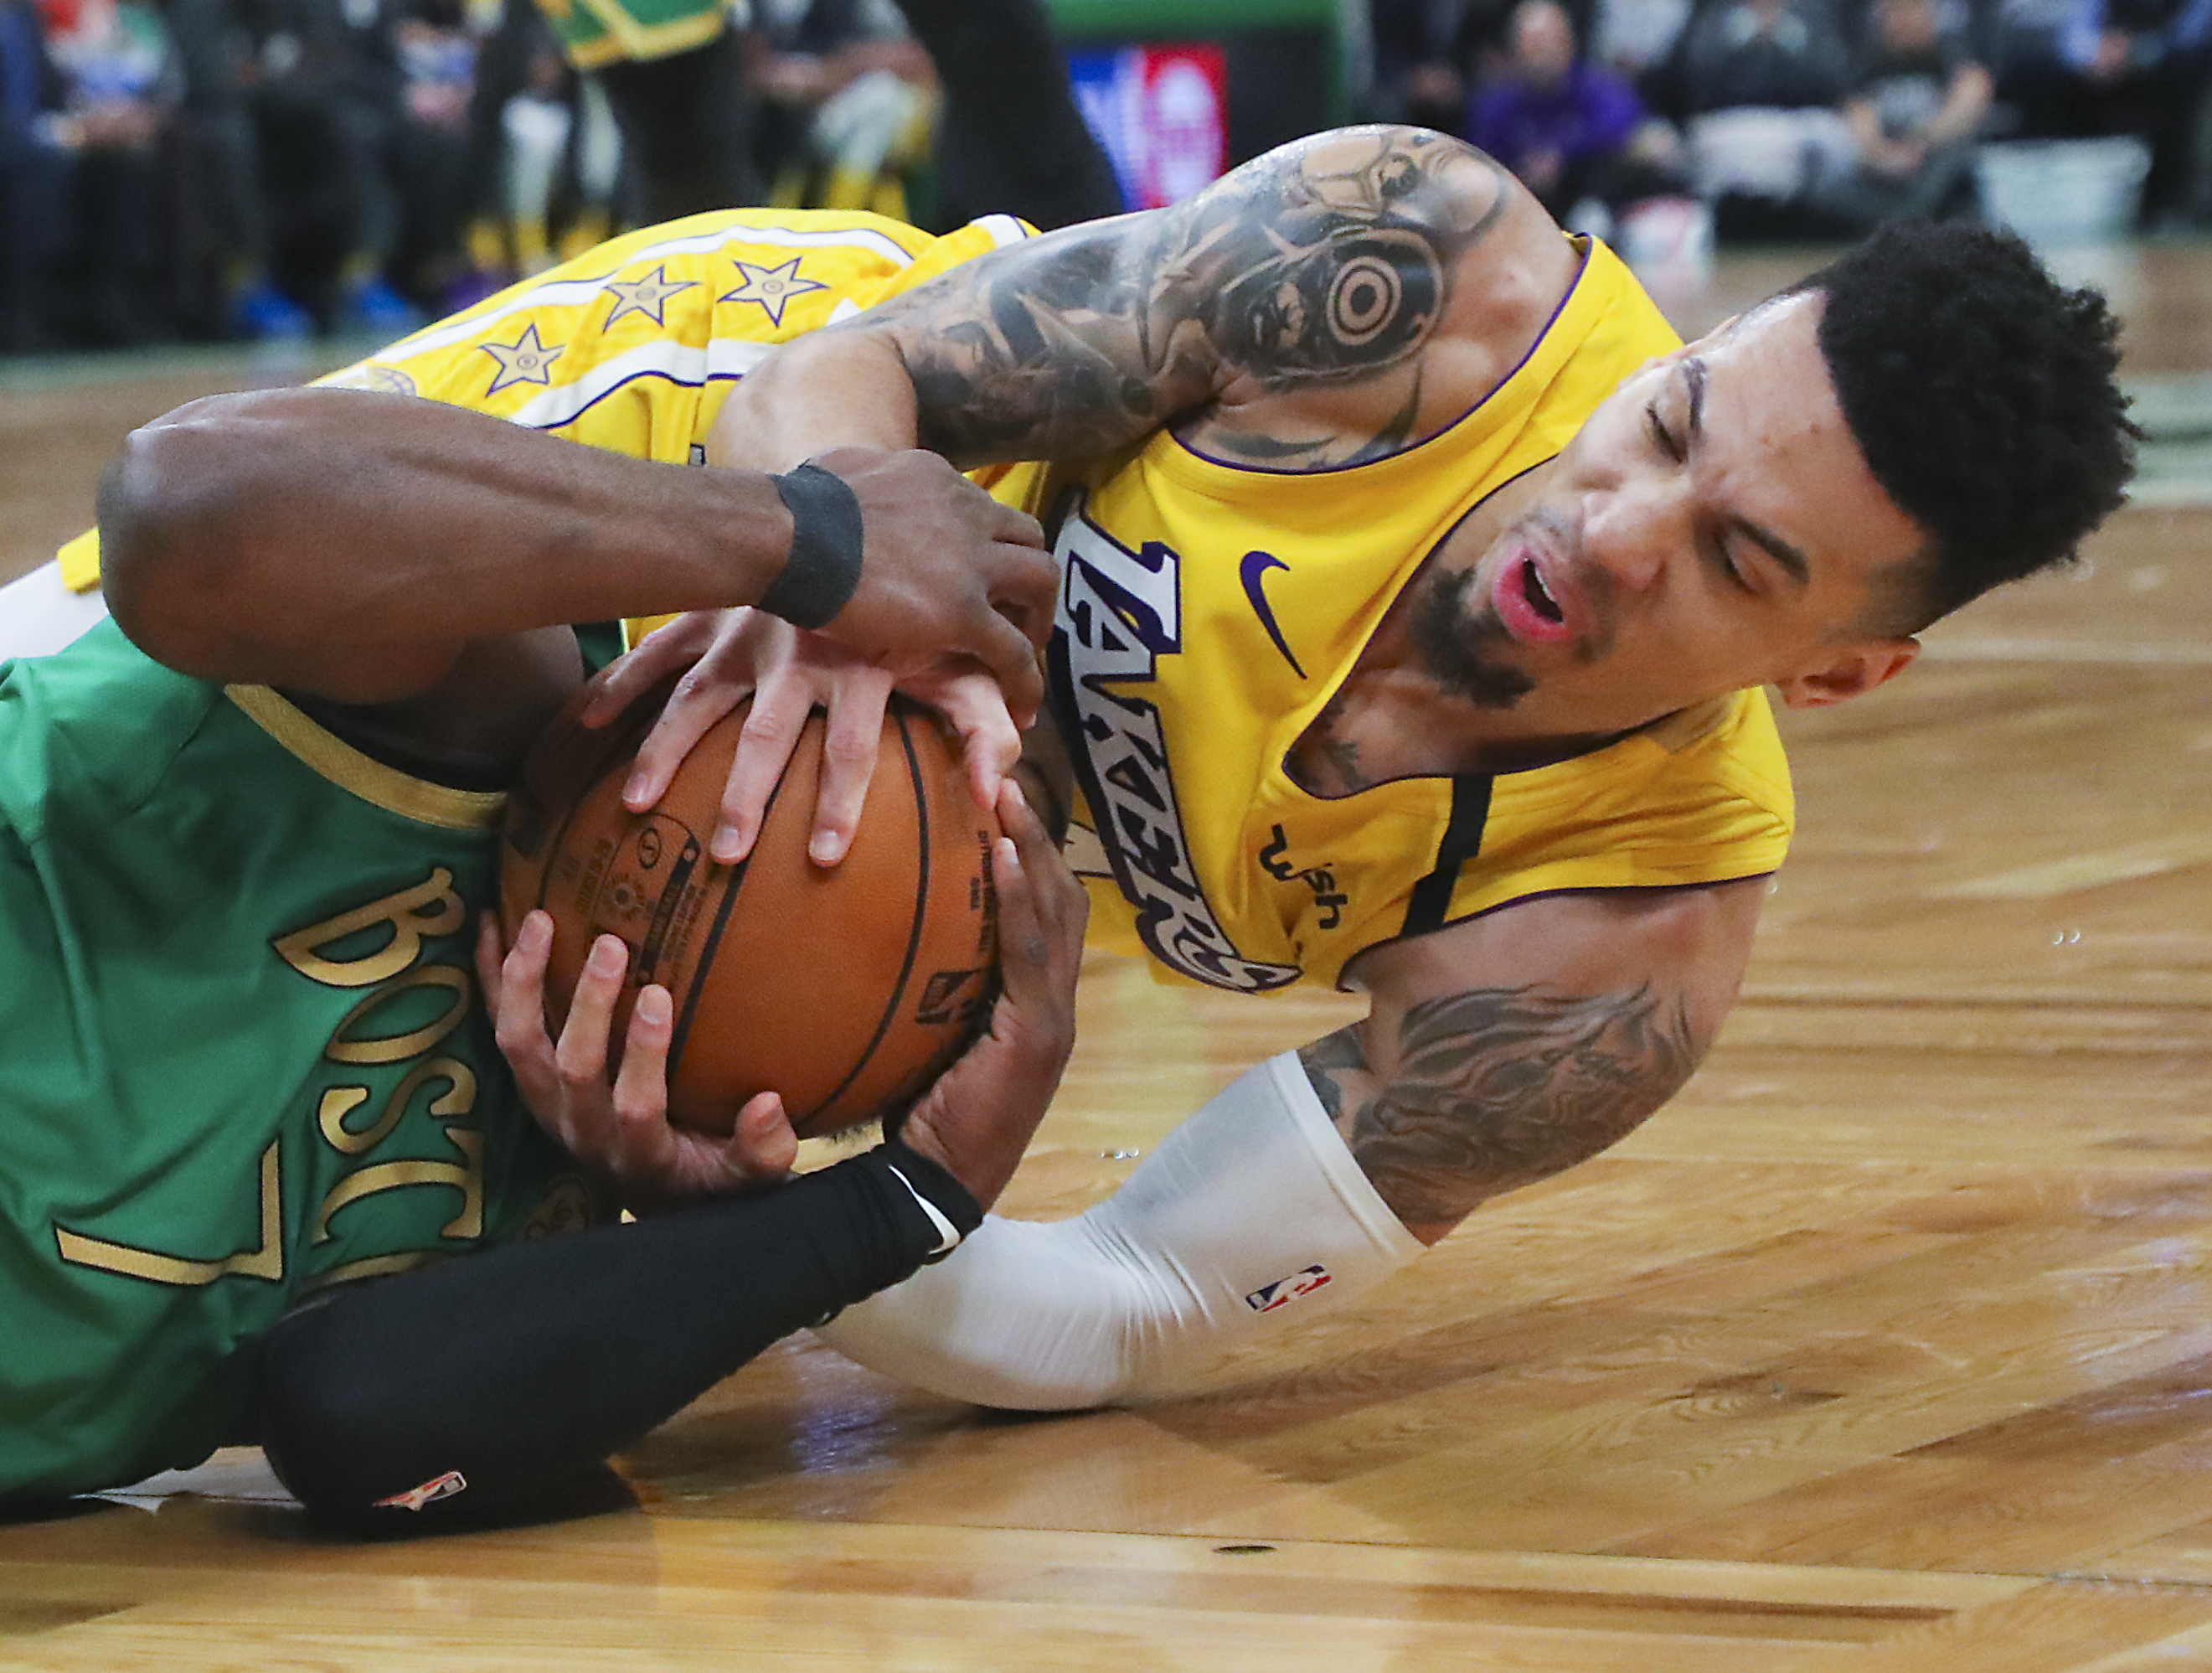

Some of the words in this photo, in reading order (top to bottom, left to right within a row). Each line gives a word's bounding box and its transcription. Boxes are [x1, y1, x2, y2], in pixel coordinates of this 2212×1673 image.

[1049, 503, 1304, 994] LAKERS
[54, 1138, 286, 1287] 7
[271, 865, 487, 1282] BOST
